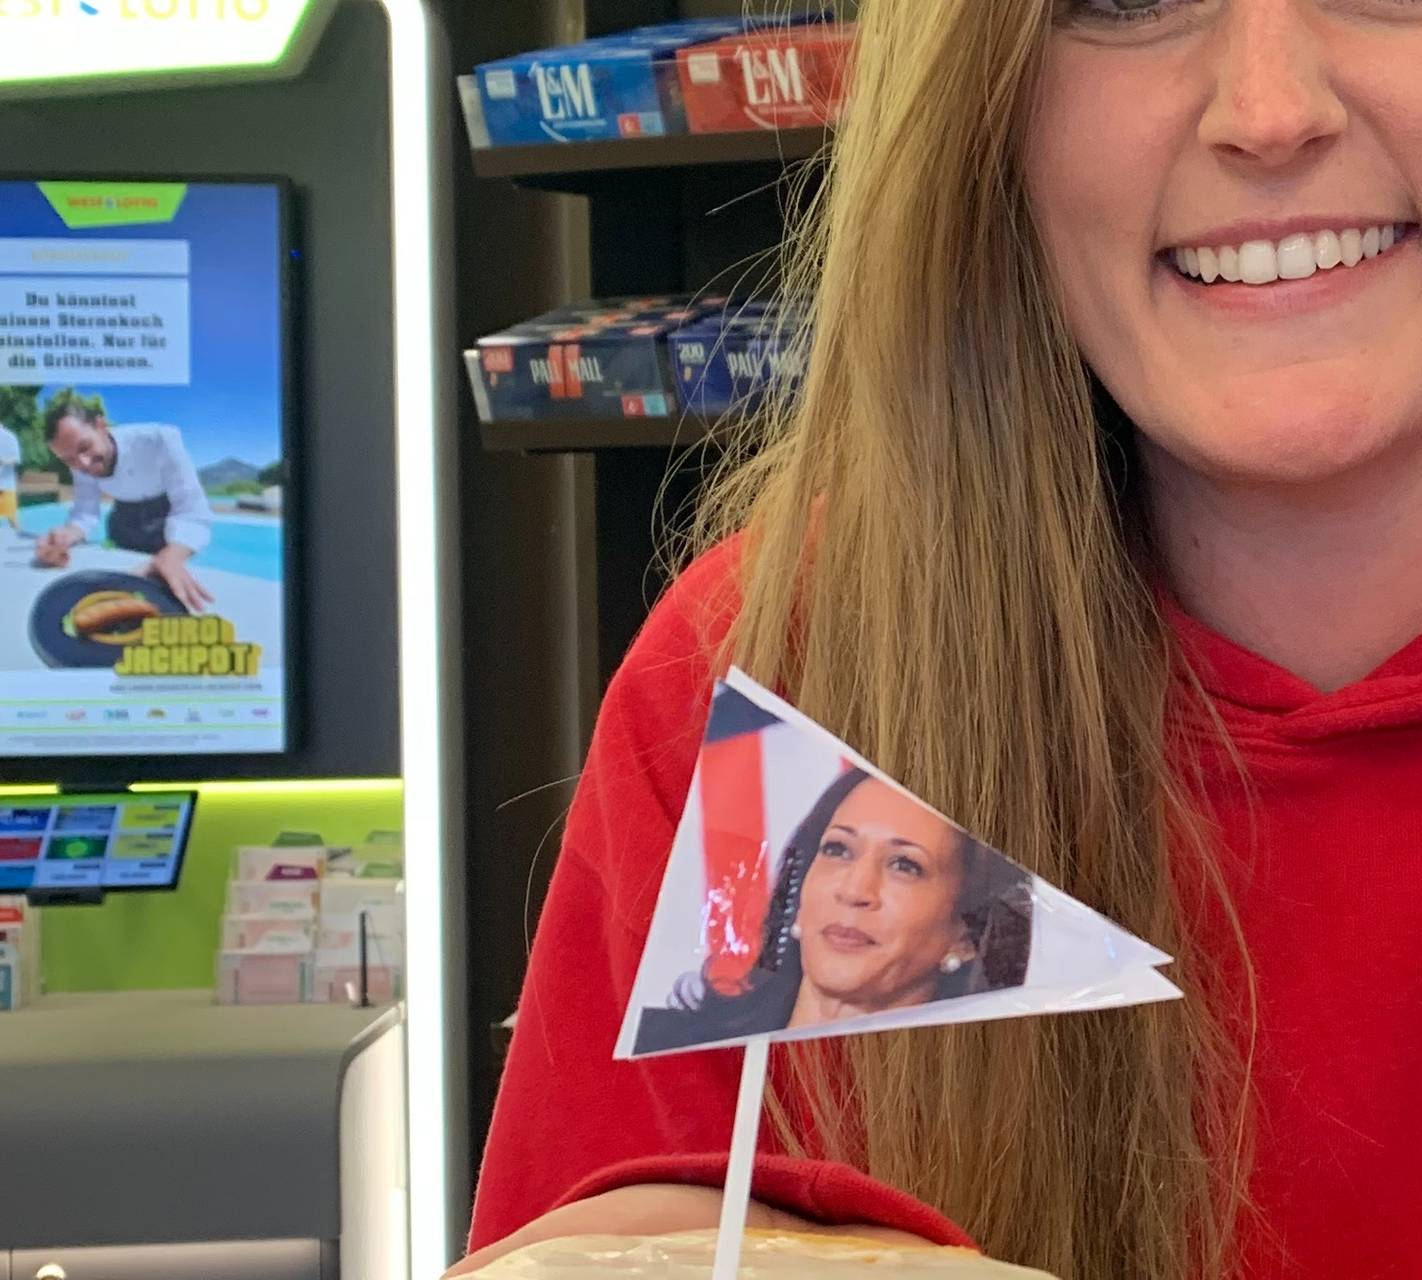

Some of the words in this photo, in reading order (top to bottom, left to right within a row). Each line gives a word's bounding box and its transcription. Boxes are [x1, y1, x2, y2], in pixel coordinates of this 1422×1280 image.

[734, 45, 804, 105] L&M
[528, 61, 597, 120] L&M
[26, 291, 49, 307] Du
[103, 332, 136, 348] Nur
[567, 355, 603, 383] MALL
[142, 617, 222, 647] EURO
[114, 643, 262, 677] JACKPOT
